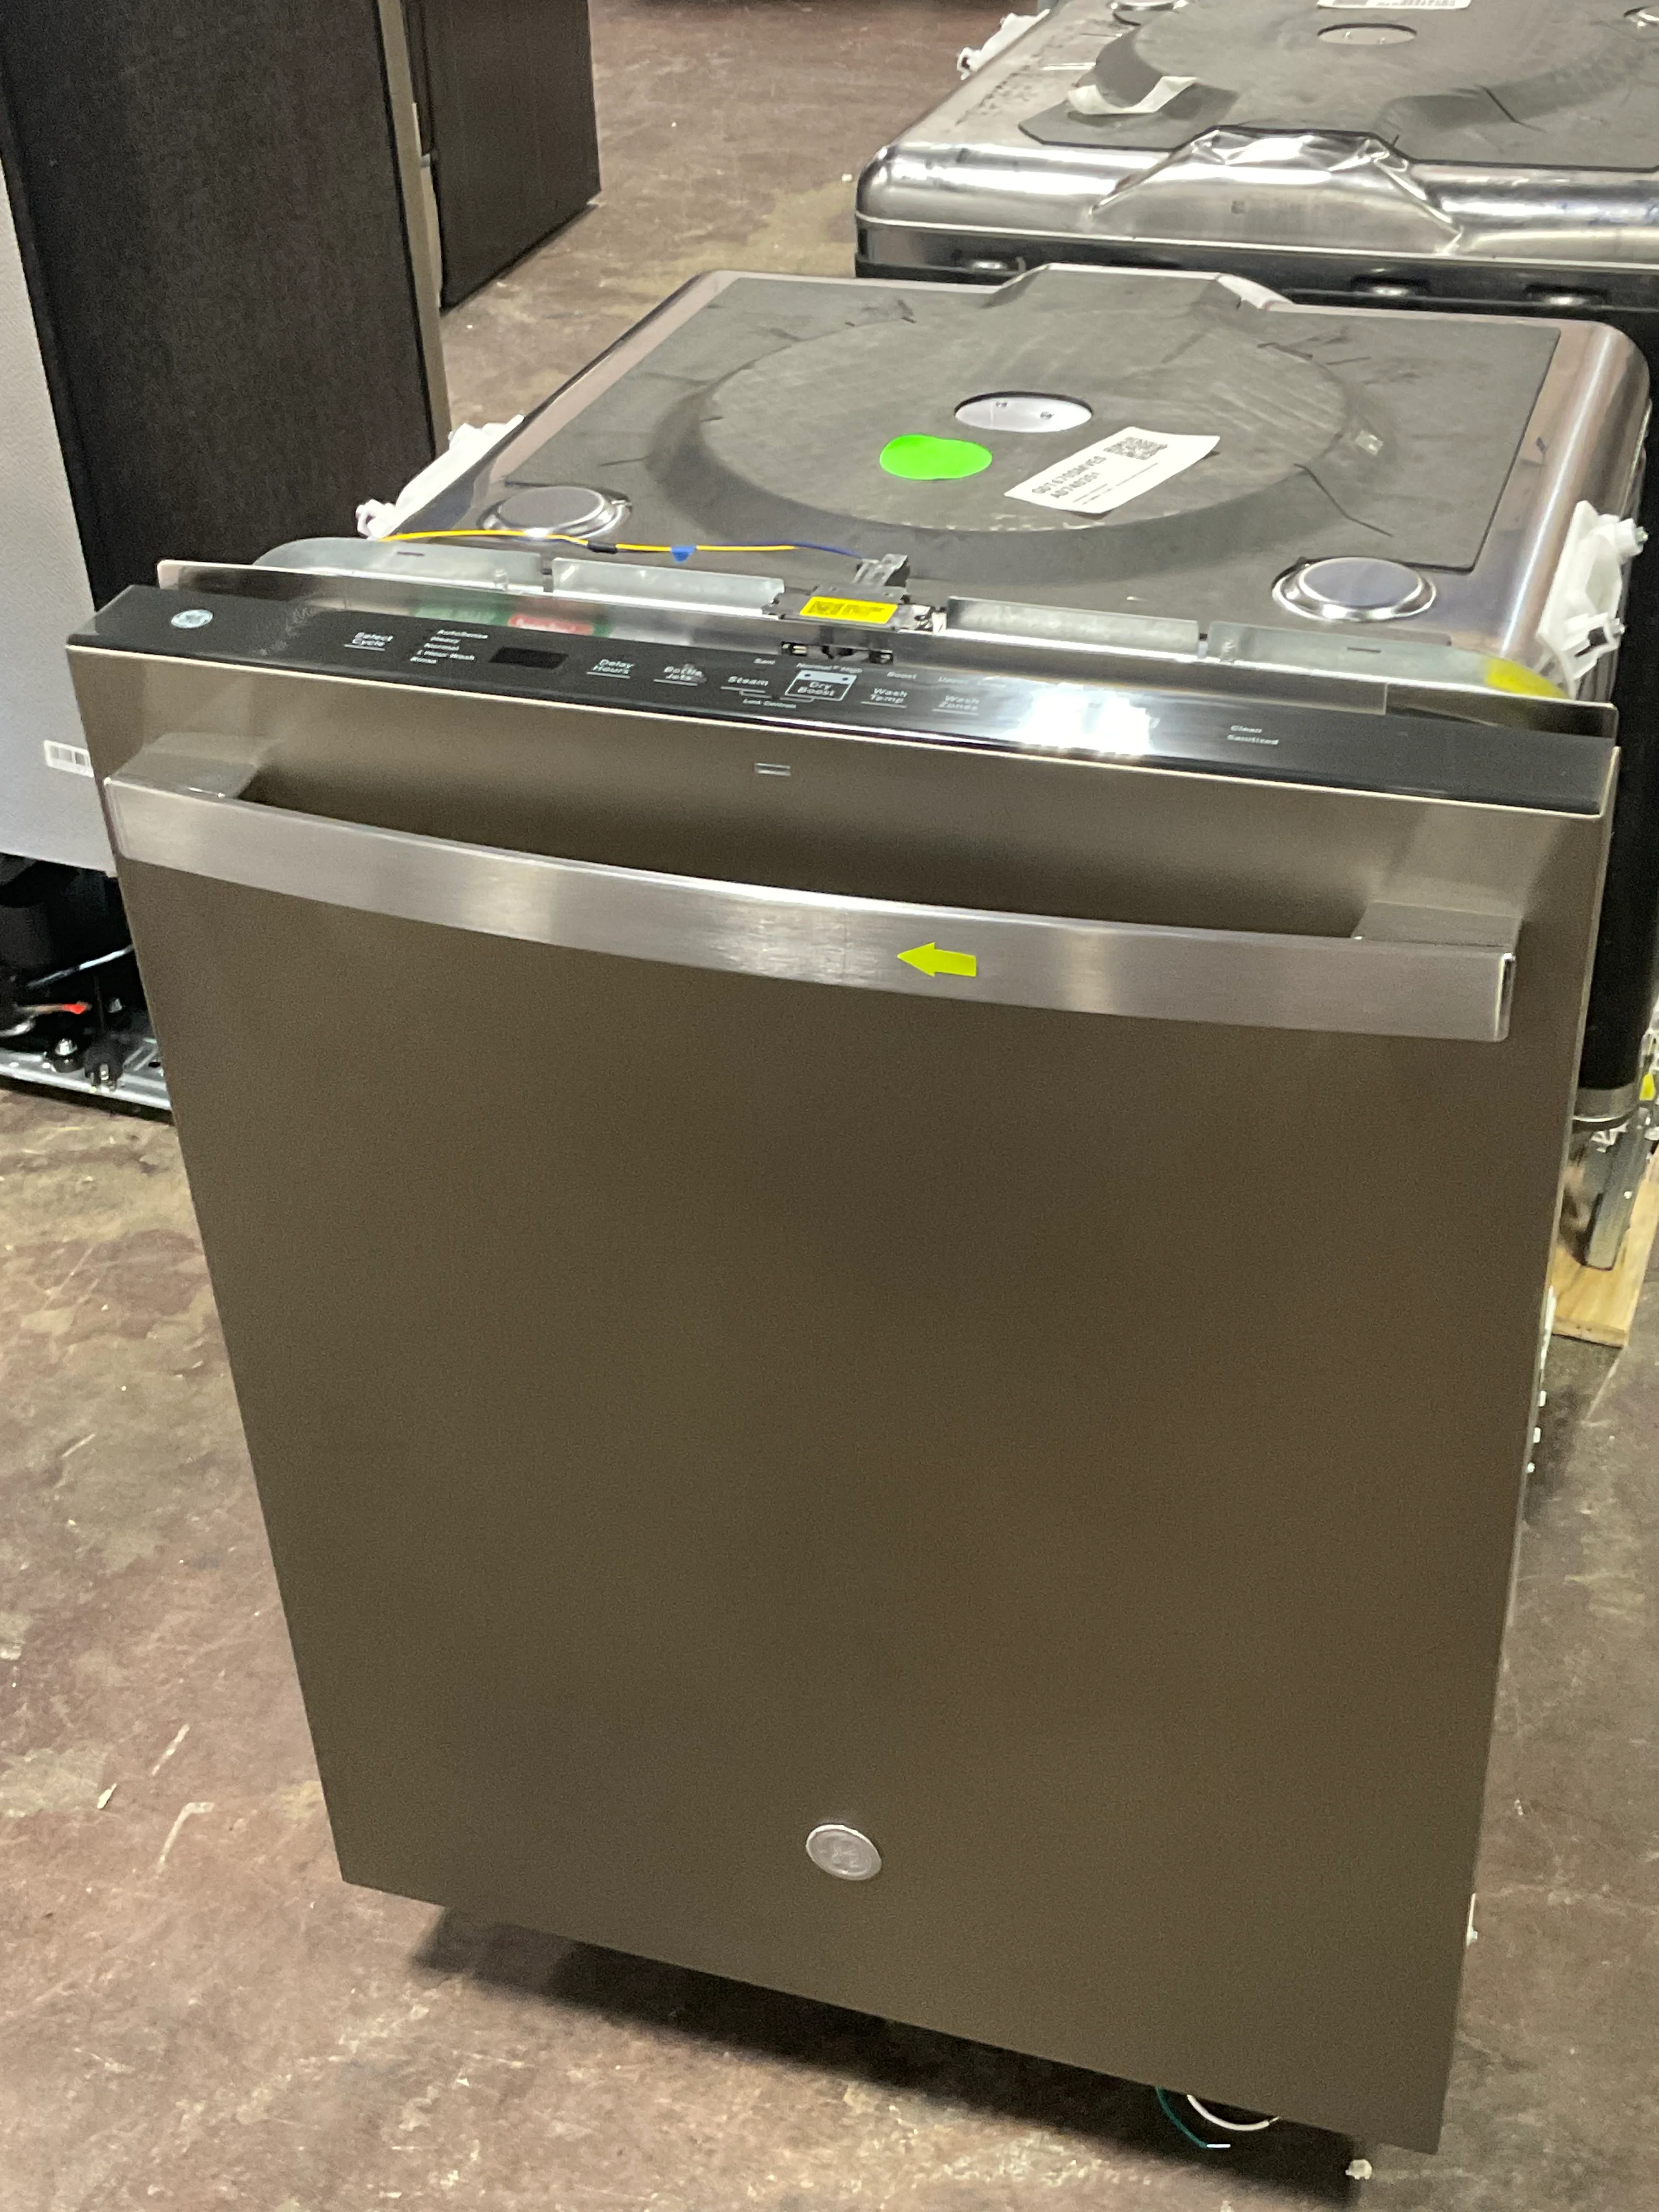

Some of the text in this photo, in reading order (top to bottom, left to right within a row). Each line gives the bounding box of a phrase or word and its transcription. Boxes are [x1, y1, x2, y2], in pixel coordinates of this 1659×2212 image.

[599, 659, 635, 669] Delay
[592, 665, 630, 674] Hours
[727, 675, 769, 686] Steam
[873, 687, 907, 697] Wash
[870, 693, 905, 704] Temp
[945, 695, 980, 705] Wash
